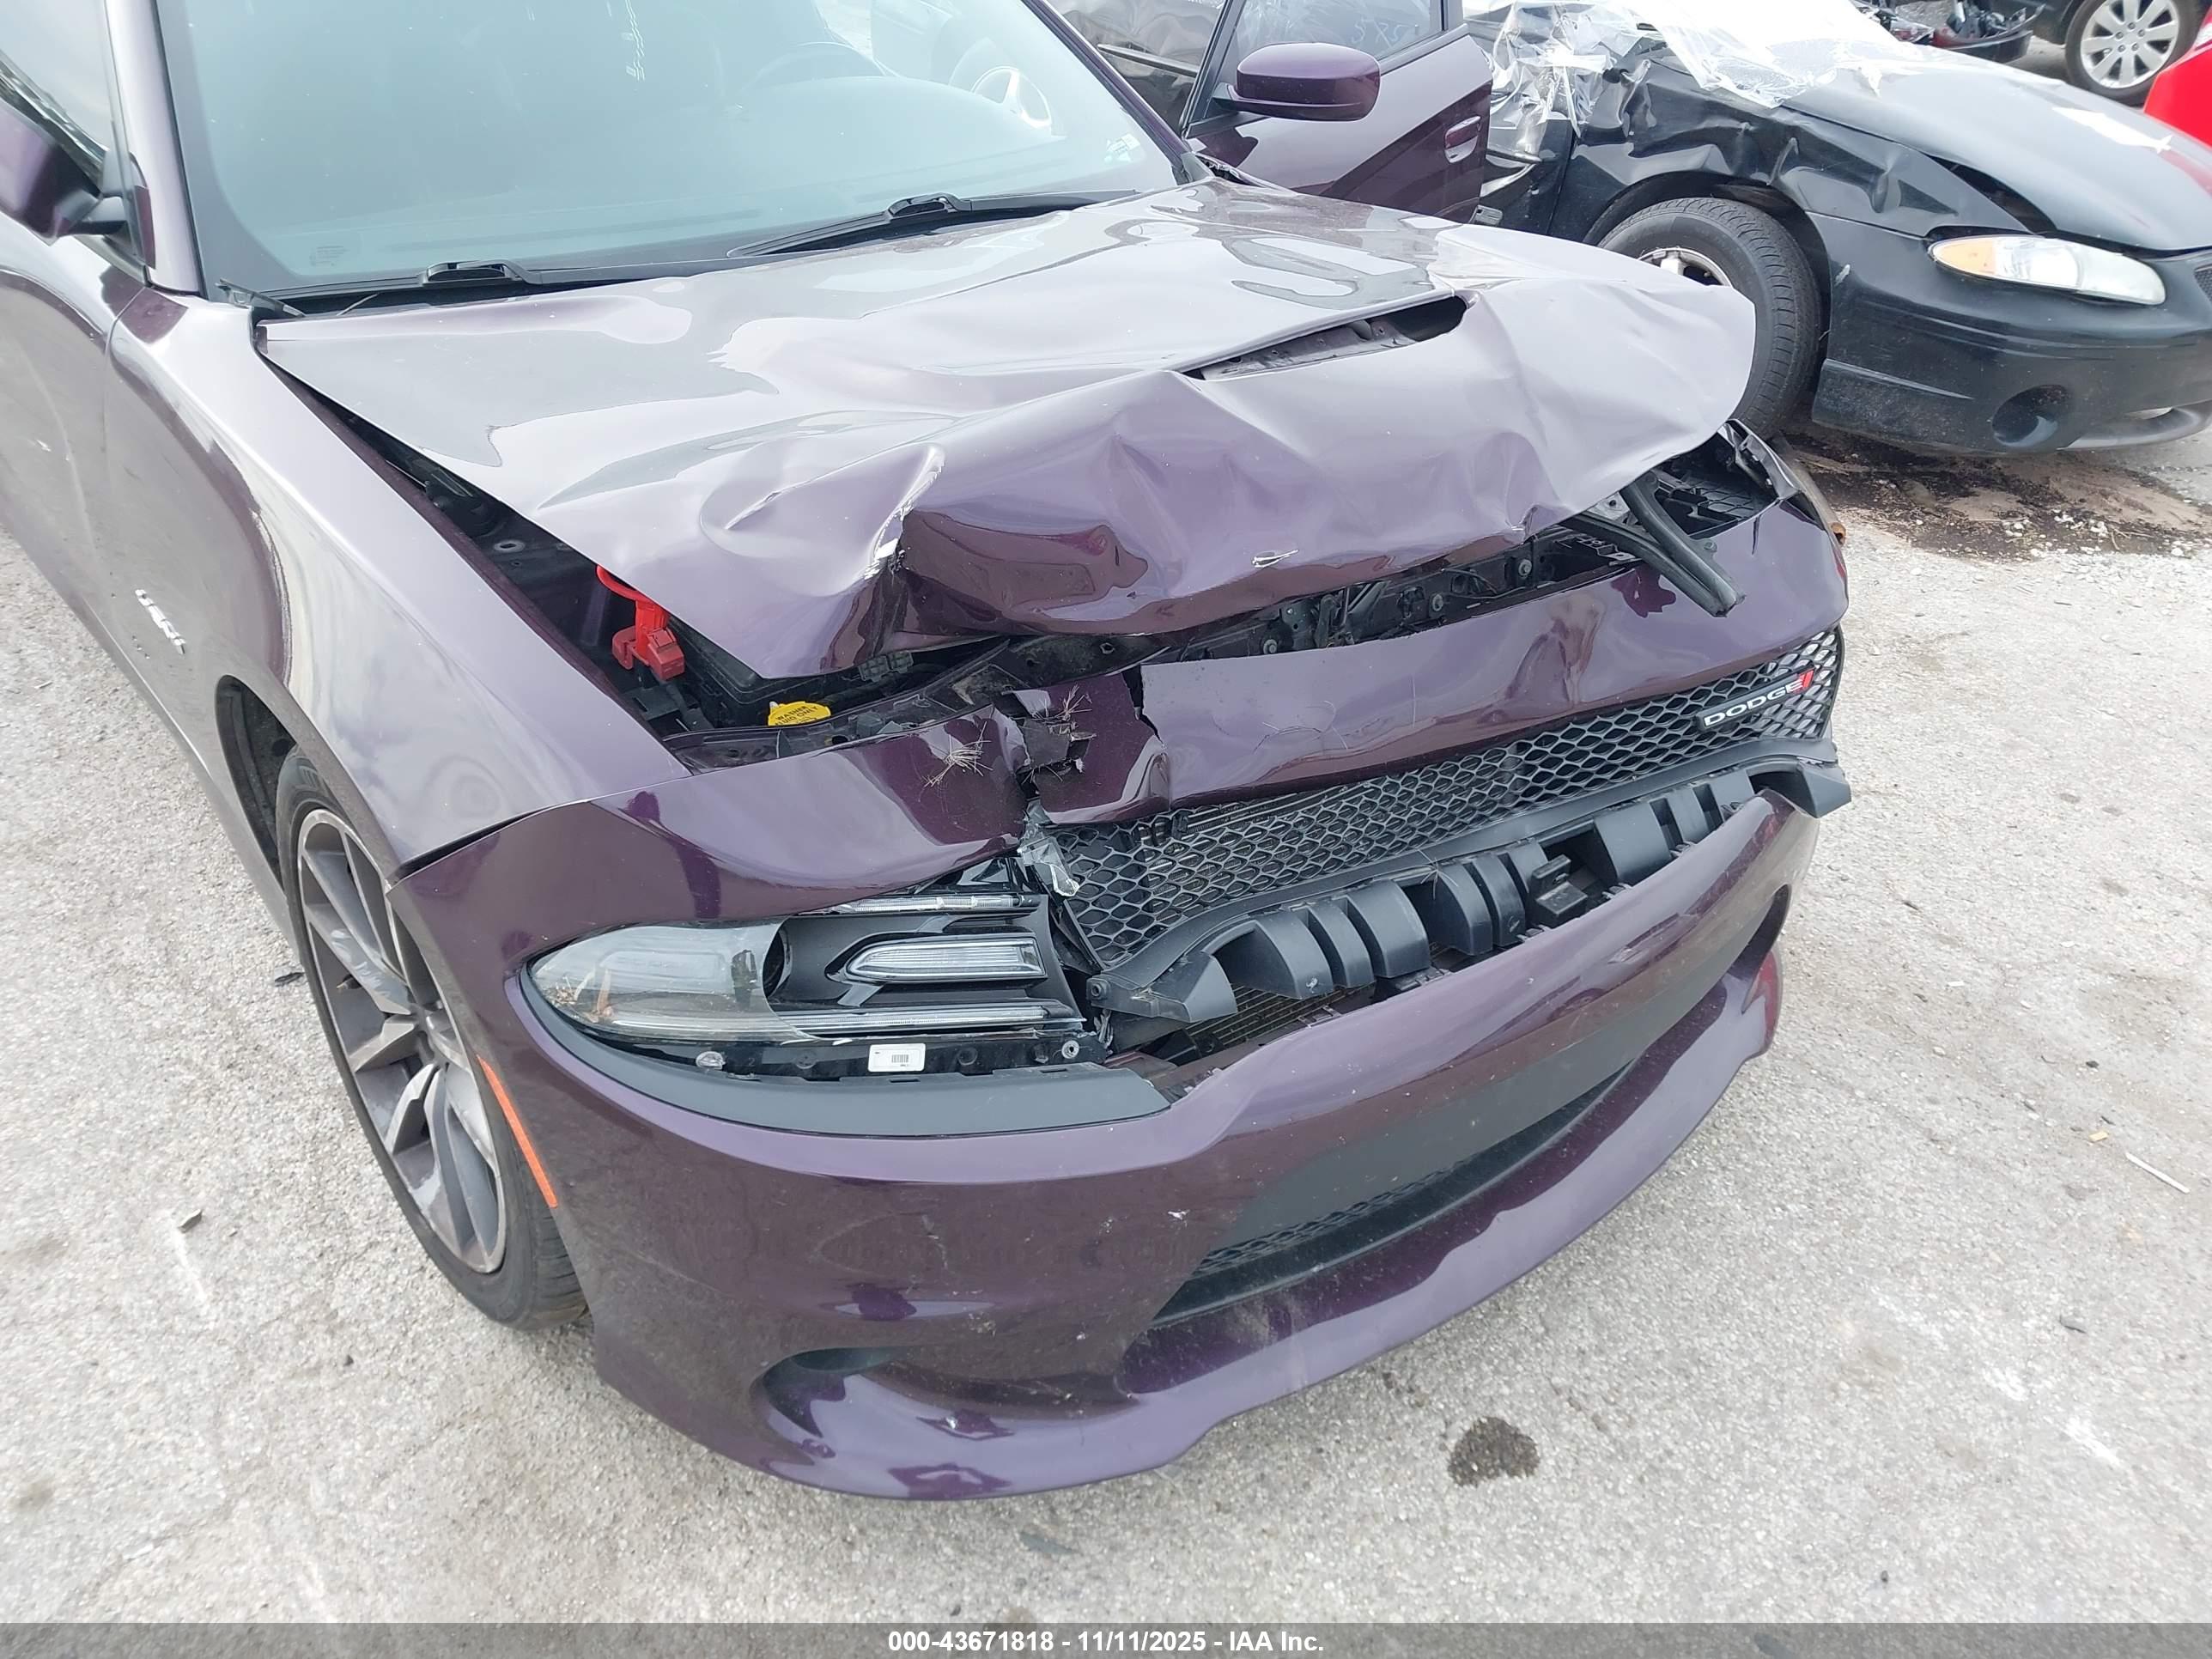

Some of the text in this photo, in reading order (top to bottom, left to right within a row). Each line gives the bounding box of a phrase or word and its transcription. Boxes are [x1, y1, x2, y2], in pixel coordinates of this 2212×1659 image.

[1704, 678, 1803, 726] DODGE
[775, 705, 807, 719] WASHER
[797, 706, 818, 717] ONLY
